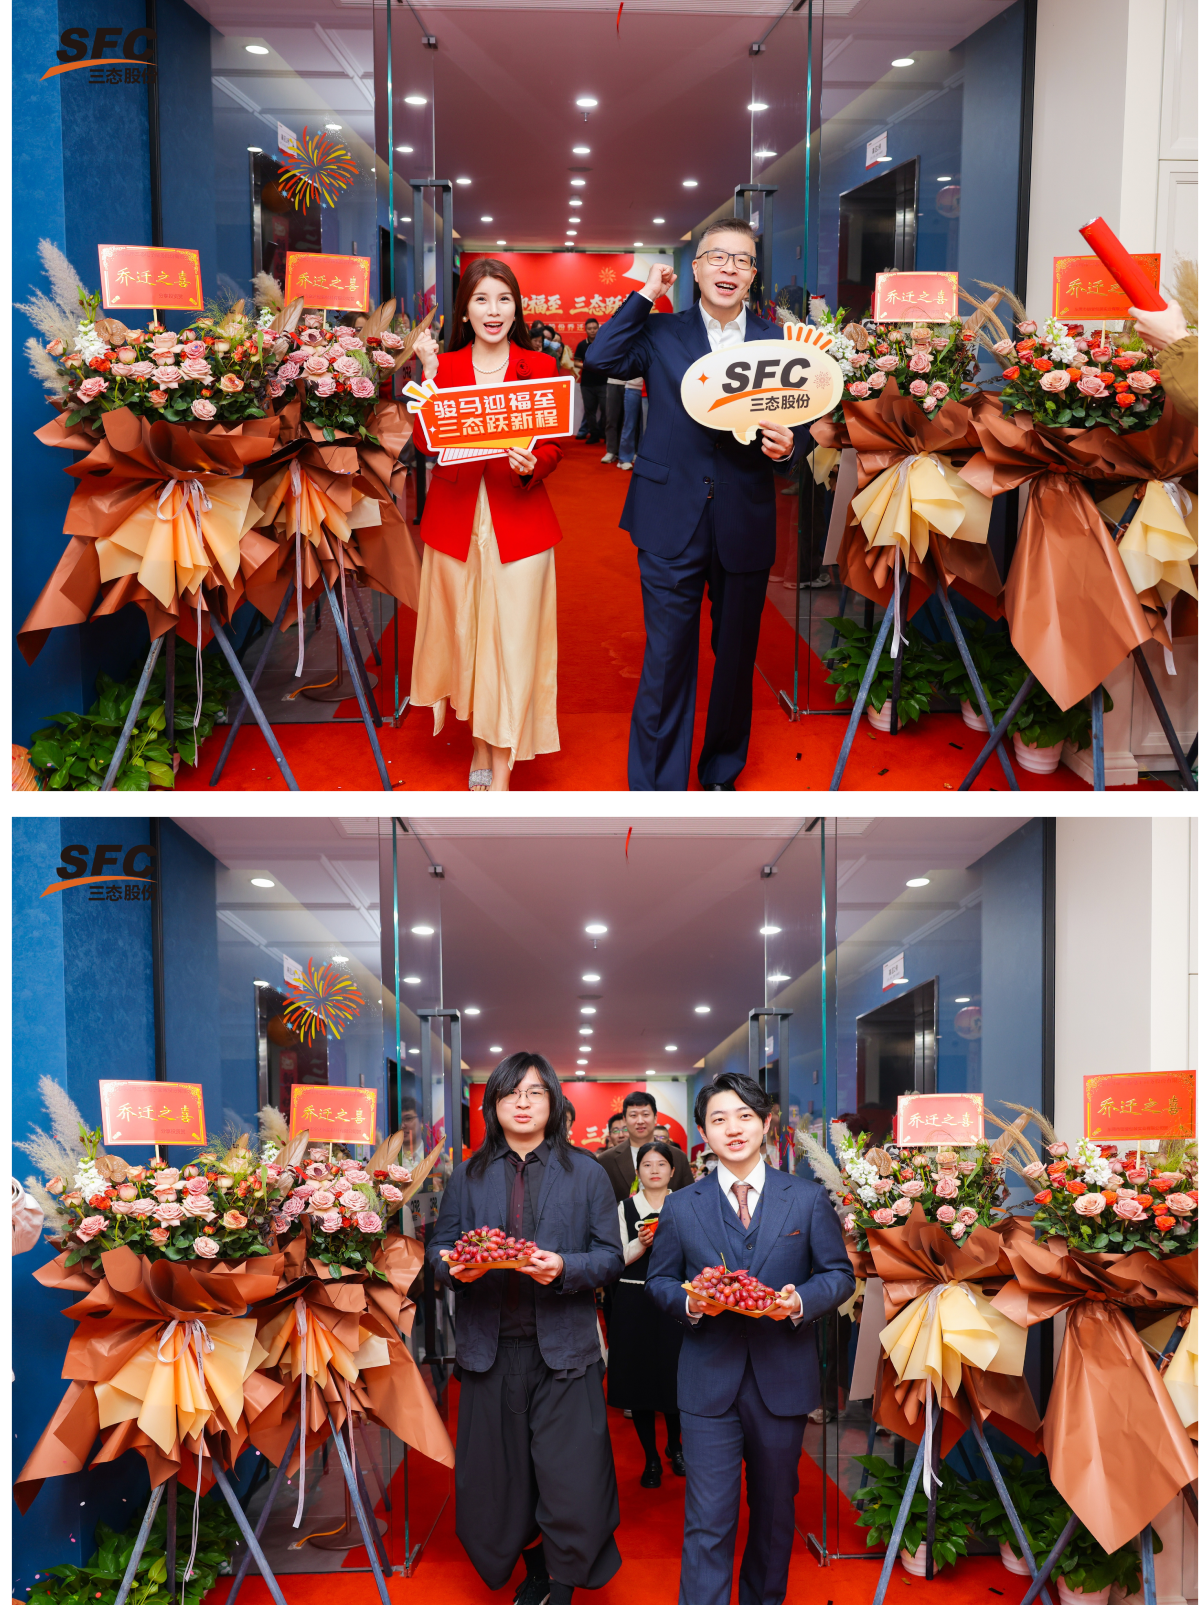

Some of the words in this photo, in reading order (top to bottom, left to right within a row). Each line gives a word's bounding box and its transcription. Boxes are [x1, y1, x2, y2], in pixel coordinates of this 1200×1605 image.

[115, 267, 191, 288] 乔迁之喜
[296, 272, 360, 292] 乔迁之喜
[885, 289, 948, 305] 乔迁之喜
[722, 357, 811, 394] SFC
[433, 389, 556, 418] 骏马迎福至
[750, 393, 811, 412] 三态股份
[437, 409, 558, 438] 三态跃新程
[116, 1102, 194, 1123] 乔迁之喜
[301, 1105, 366, 1125] 乔迁之喜
[1097, 1095, 1182, 1118] 乔迁之喜
[907, 1112, 974, 1128] 乔迁之喜
